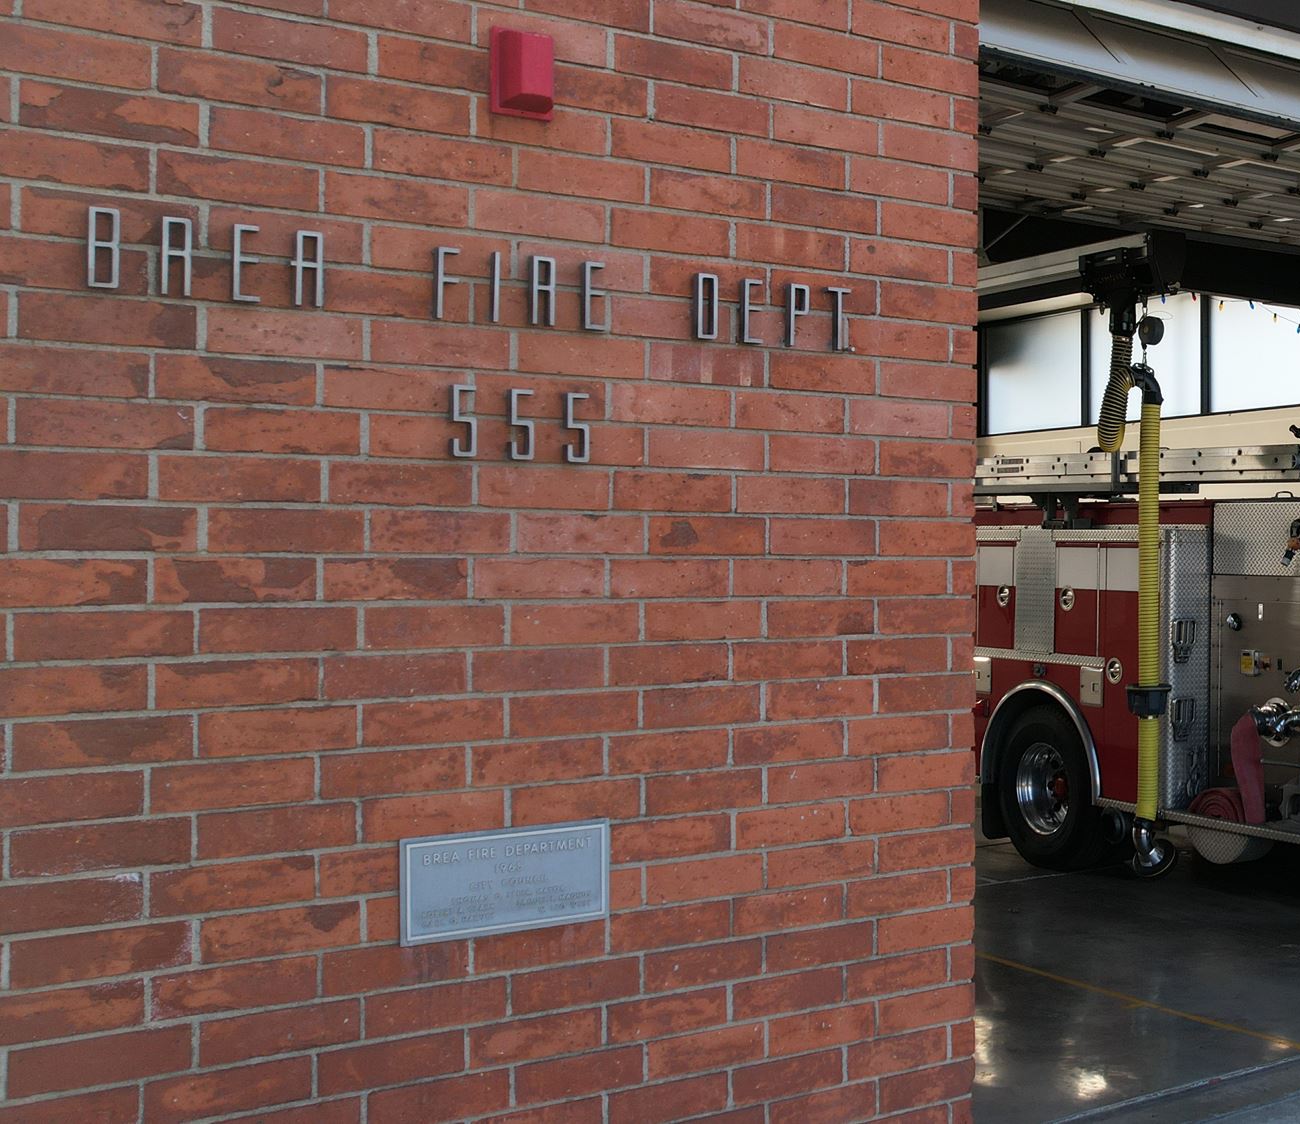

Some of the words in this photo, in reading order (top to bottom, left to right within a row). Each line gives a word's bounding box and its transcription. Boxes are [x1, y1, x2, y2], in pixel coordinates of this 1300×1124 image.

[87, 206, 324, 307] BREA
[432, 247, 605, 331] FIRE
[449, 384, 590, 464] 555
[422, 851, 461, 867] BREA
[468, 847, 498, 861] FIRE
[504, 836, 594, 857] DEPARTMENT
